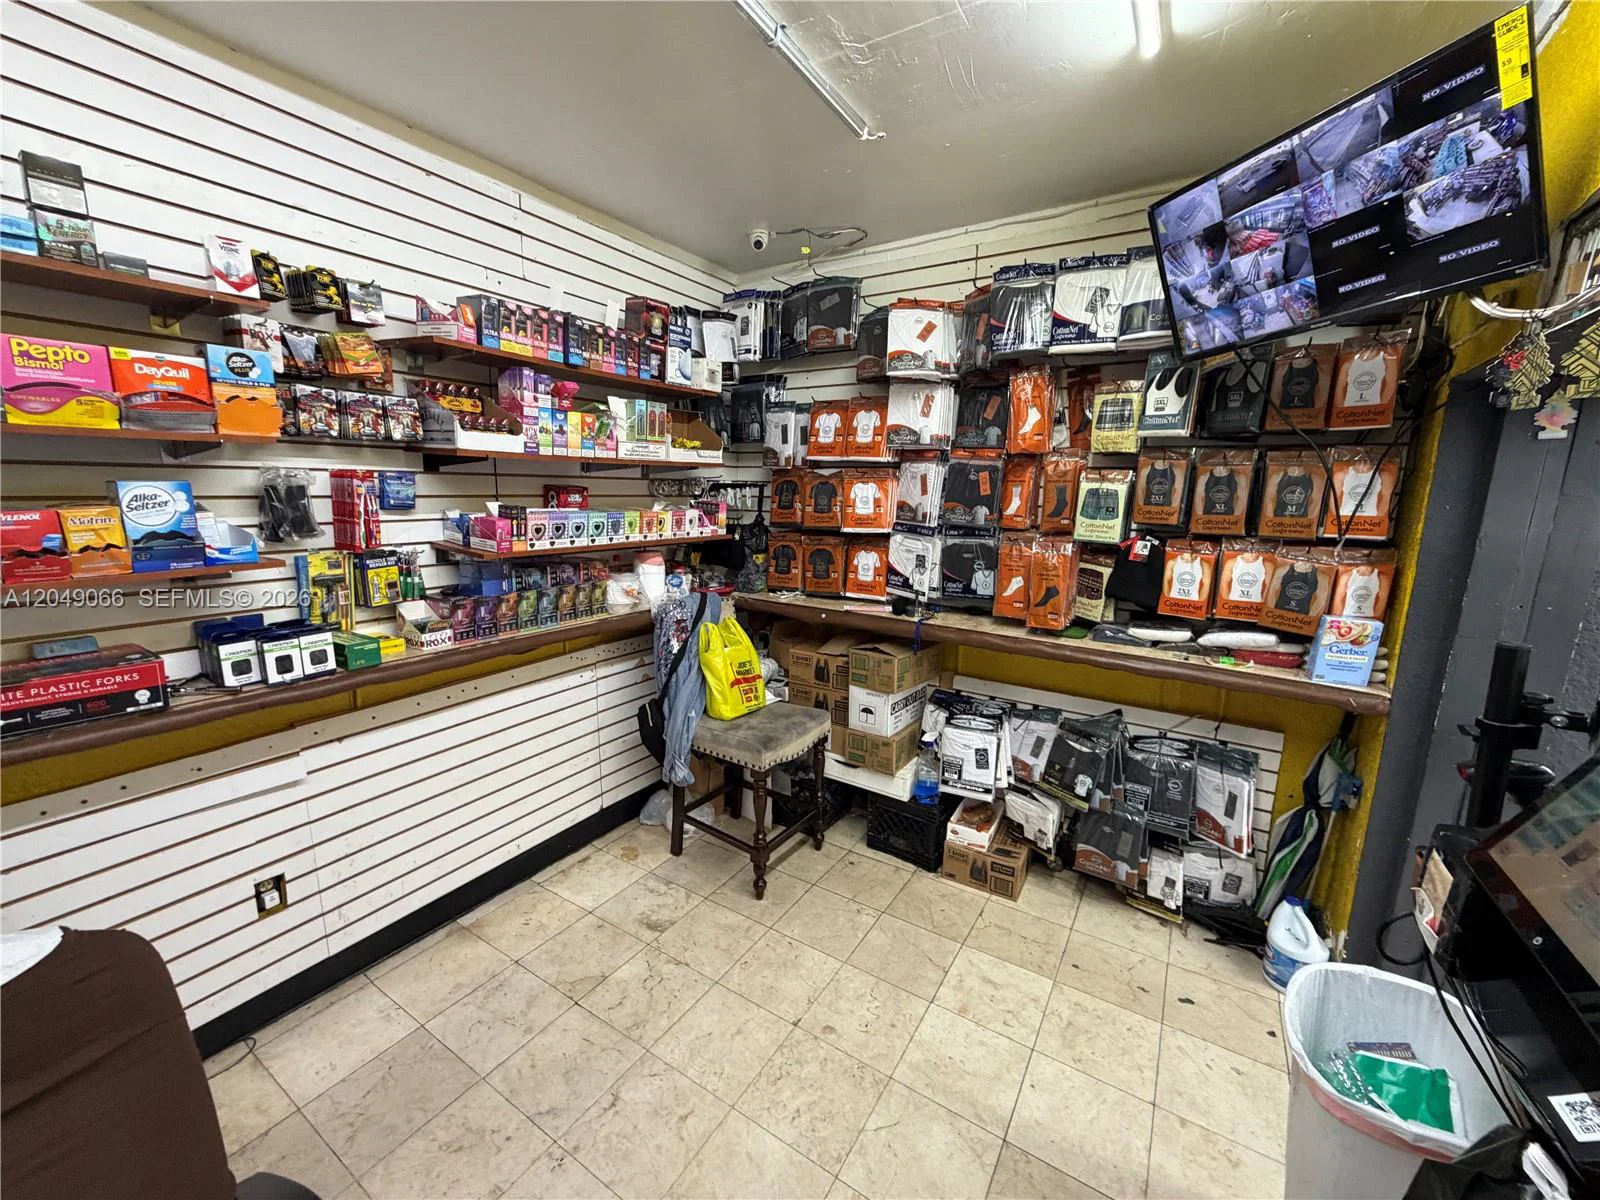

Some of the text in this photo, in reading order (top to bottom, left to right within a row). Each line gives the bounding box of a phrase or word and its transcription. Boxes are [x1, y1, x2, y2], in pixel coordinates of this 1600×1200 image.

[1422, 66, 1485, 102] NO VIDEO
[1332, 226, 1380, 249] NO VIDEO
[1438, 240, 1499, 264] NO VIDEO
[1338, 274, 1386, 294] NO VIDEO
[483, 329, 498, 337] ULTRA
[1053, 326, 1080, 335] CottonNet
[9, 337, 91, 364] Pepto
[549, 343, 562, 351] ULTRA
[13, 356, 64, 371] Bismol
[228, 360, 254, 369] Seltzer
[133, 362, 191, 379] DayQuil
[1335, 409, 1387, 419] CottonNet
[127, 493, 162, 504] Alka-
[125, 499, 171, 513] Seltzer
[0, 513, 41, 521] YLENOL
[1137, 508, 1177, 516] CottonNet
[69, 516, 112, 526] Motrin
[1080, 521, 1116, 530] CottonNet
[1196, 518, 1239, 526] CottonNet
[1265, 520, 1313, 529] CottonNet
[1177, 587, 1192, 595] 2XL
[1239, 589, 1253, 597] XL
[1163, 599, 1204, 611] CottonNet
[1222, 602, 1262, 612] CottonNe
[1265, 610, 1312, 625] CottonNet
[426, 637, 447, 649] ROX
[1329, 645, 1368, 656] Gerber
[1, 672, 140, 700] ITE PLASTIC FORKS
[55, 690, 83, 699] STRONG
[90, 684, 118, 693] DURABLE
[891, 701, 906, 714] CARRY
[948, 781, 985, 792] Supreme
